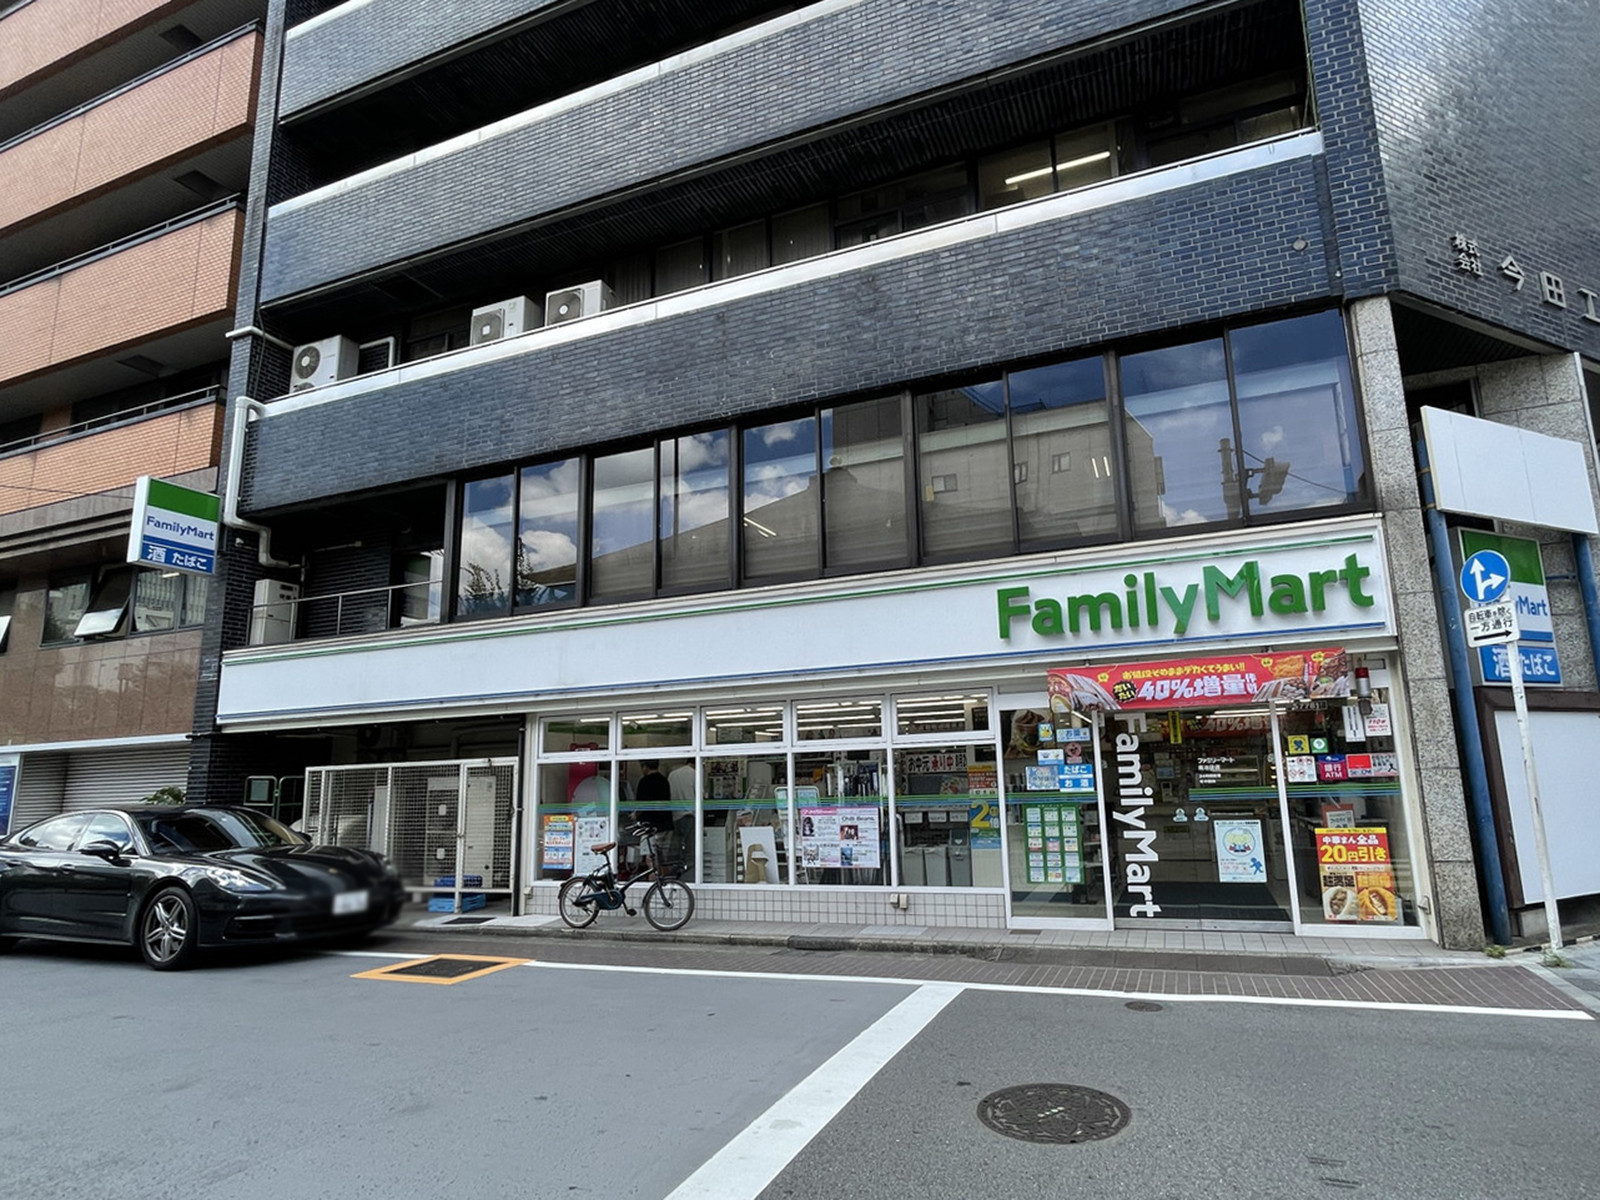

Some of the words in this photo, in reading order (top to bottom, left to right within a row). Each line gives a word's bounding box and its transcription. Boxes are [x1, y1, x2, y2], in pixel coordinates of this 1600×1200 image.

[1458, 253, 1484, 276] 会社
[147, 515, 214, 540] FamilyMart
[147, 545, 167, 563] 酒
[172, 552, 207, 570] たばこ
[997, 553, 1374, 640] FamilyMart
[1468, 606, 1512, 623] 自転車を除く
[1470, 618, 1513, 632] 一方通行
[1518, 653, 1556, 676] たばこ
[1064, 765, 1087, 774] たばこ
[1112, 712, 1162, 917] FamilyMart
[1320, 845, 1387, 863] 20円引き
